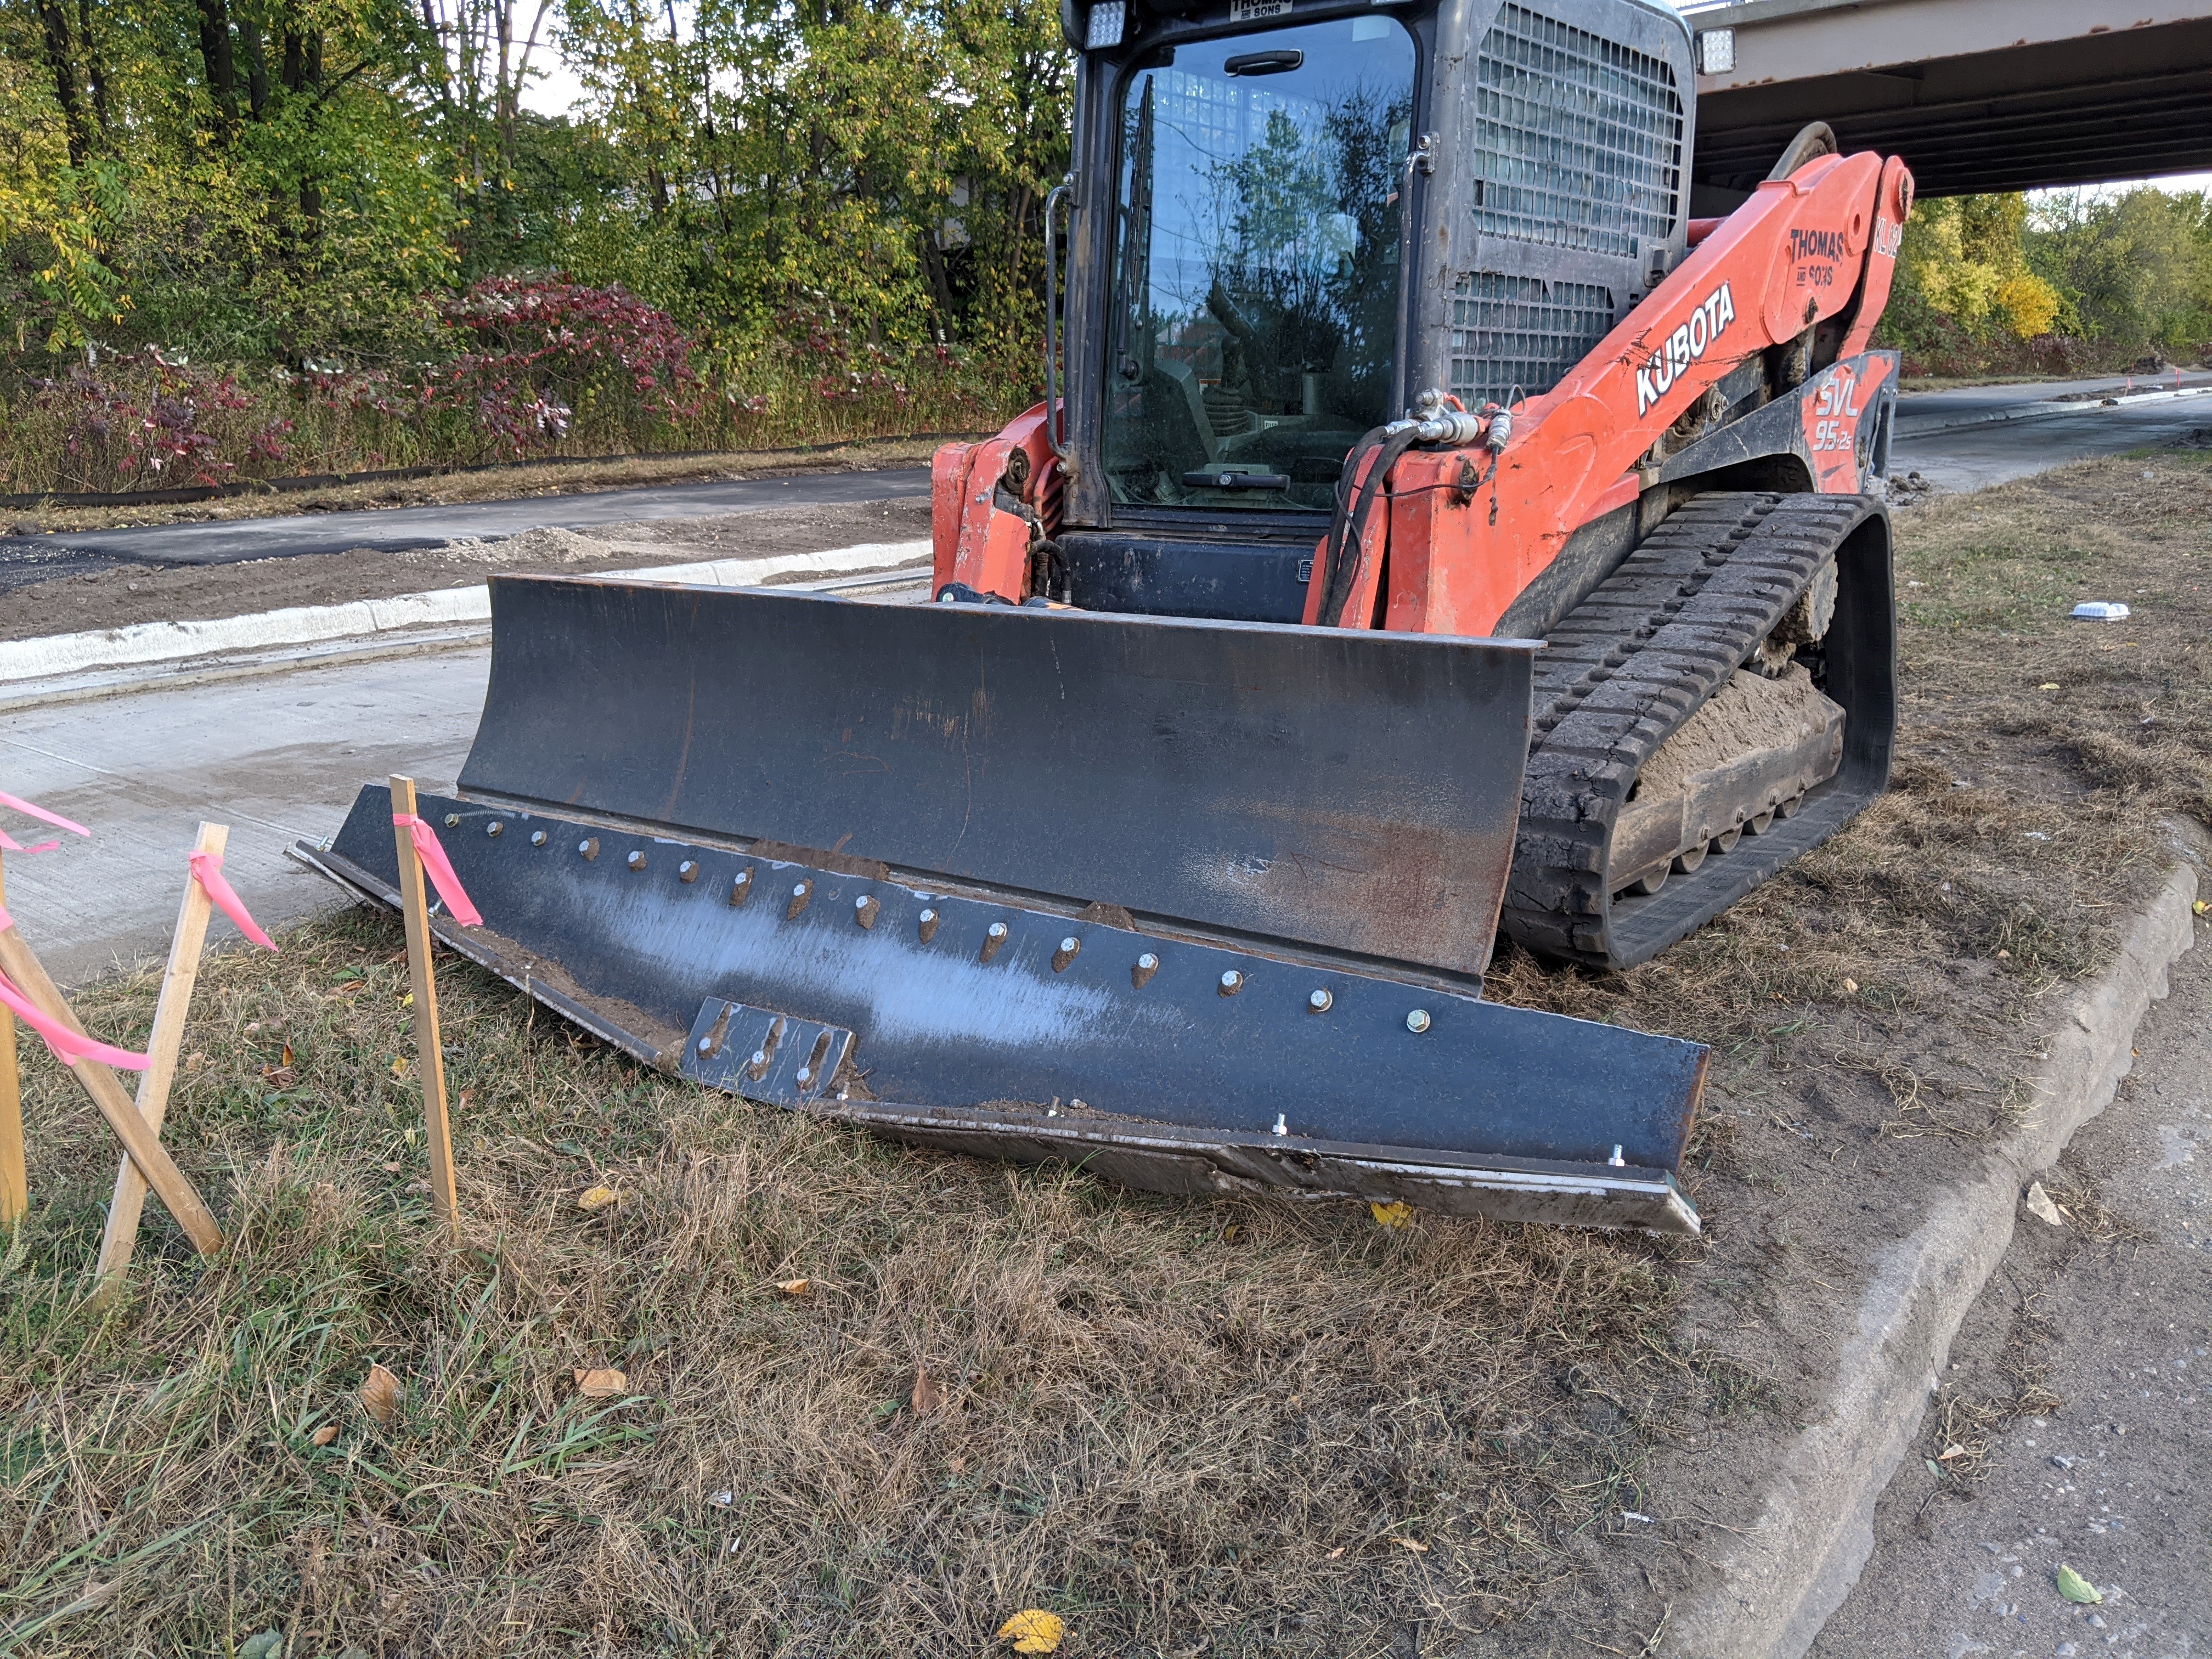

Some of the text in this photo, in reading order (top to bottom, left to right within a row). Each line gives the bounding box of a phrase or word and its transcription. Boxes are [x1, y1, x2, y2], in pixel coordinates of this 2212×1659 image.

[1254, 4, 1281, 17] SONS
[1790, 229, 1844, 265] THOMAS
[1636, 283, 1735, 417] KUBOTA
[1816, 377, 1859, 417] SVL
